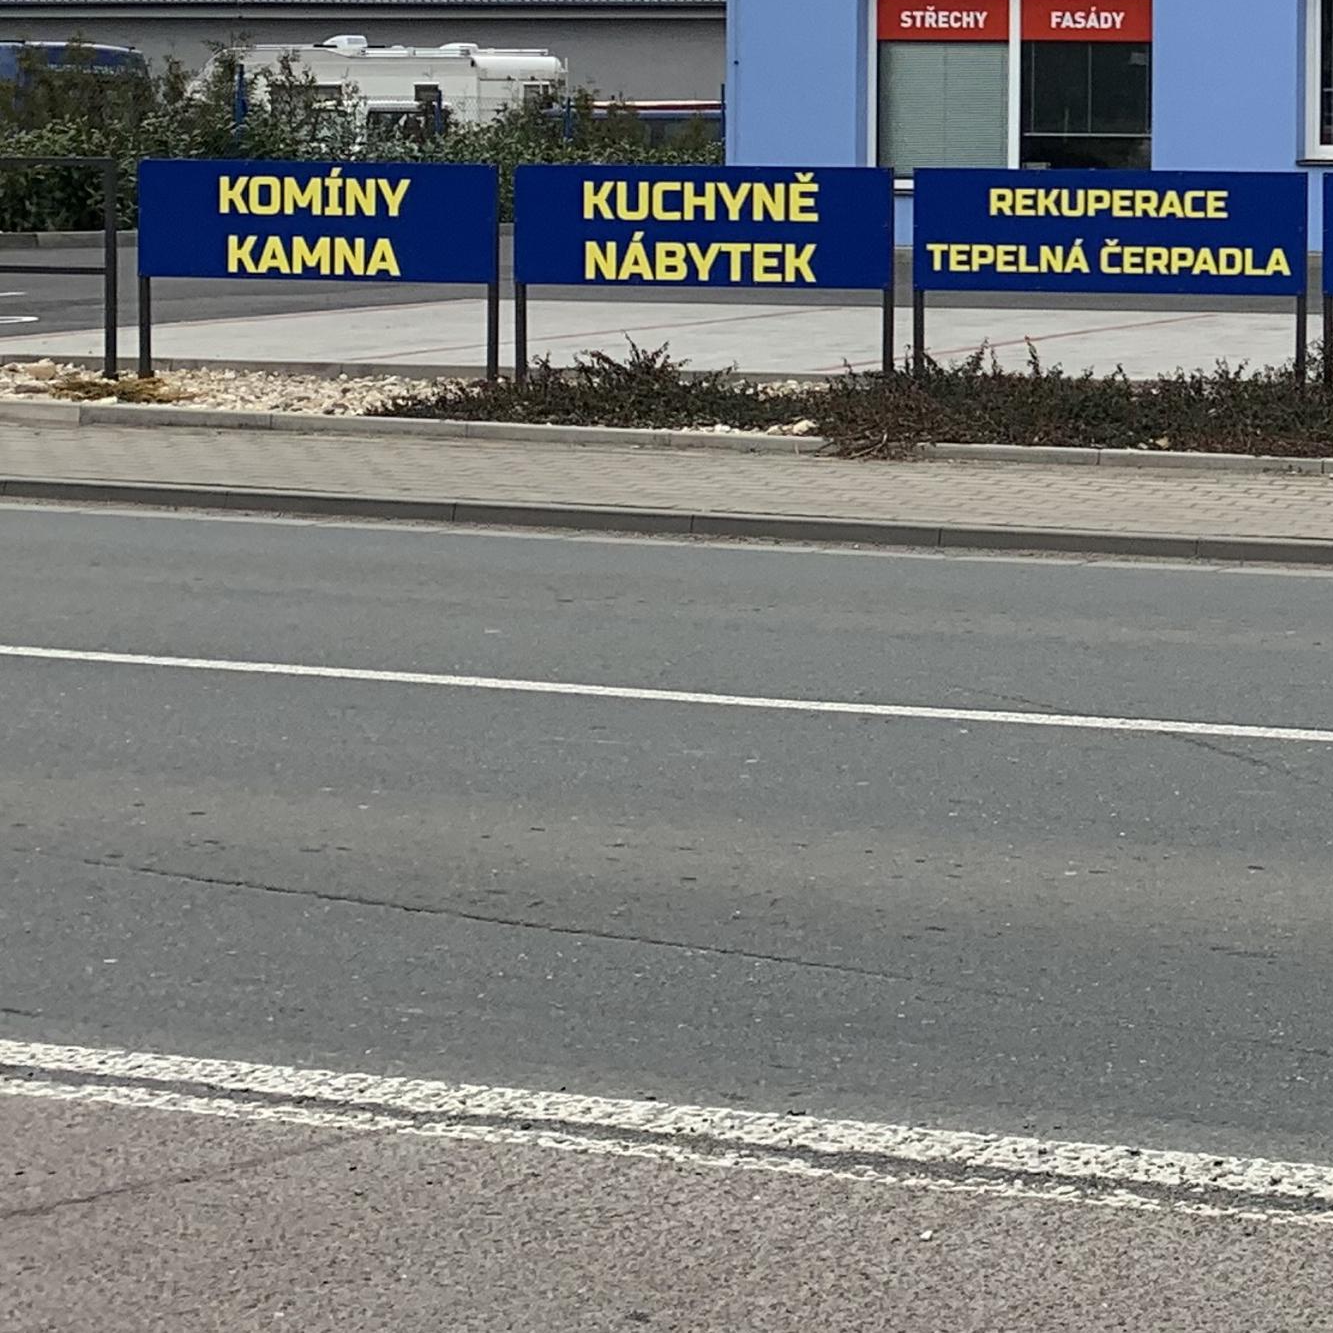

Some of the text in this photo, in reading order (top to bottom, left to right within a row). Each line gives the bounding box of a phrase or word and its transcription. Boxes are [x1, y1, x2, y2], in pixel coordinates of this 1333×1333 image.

[900, 5, 988, 28] STŘECHY
[1050, 6, 1125, 29] FASÁDY
[219, 168, 410, 216] KOMÍNY
[583, 172, 818, 222] KUCHYNĚ
[989, 188, 1228, 219] REKUPERACE
[227, 234, 400, 276] KAMNA
[584, 231, 816, 283] NÁBYTEK
[927, 238, 1291, 276] TEPELNÁ ČERPADLA
